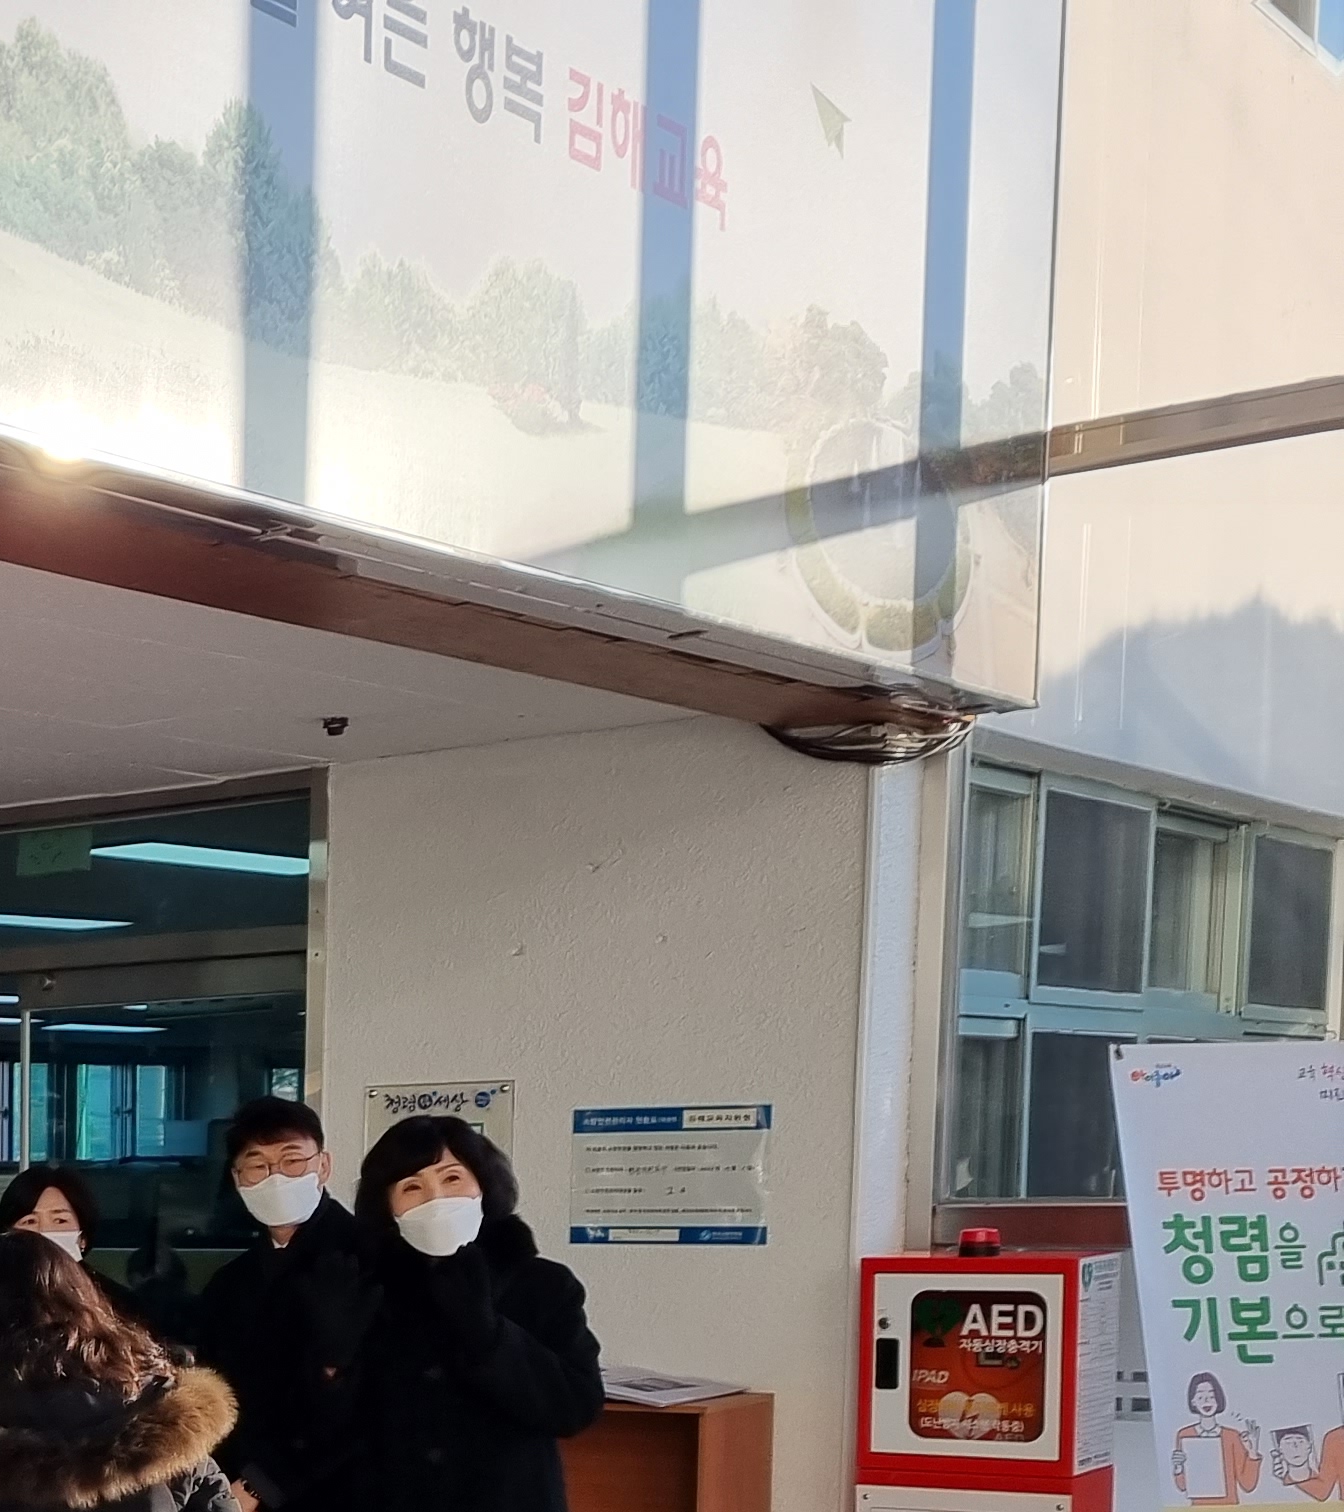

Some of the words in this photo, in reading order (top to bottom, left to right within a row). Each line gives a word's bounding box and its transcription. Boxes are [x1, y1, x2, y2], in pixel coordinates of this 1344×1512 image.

[453, 6, 544, 144] 행복
[567, 67, 728, 231] 김해교육
[1157, 1167, 1258, 1202] 투명하고
[1266, 1165, 1344, 1201] 공정하
[1161, 1213, 1307, 1285] 청렴을
[959, 1302, 1045, 1338] AED
[1171, 1295, 1344, 1365] 기본으로
